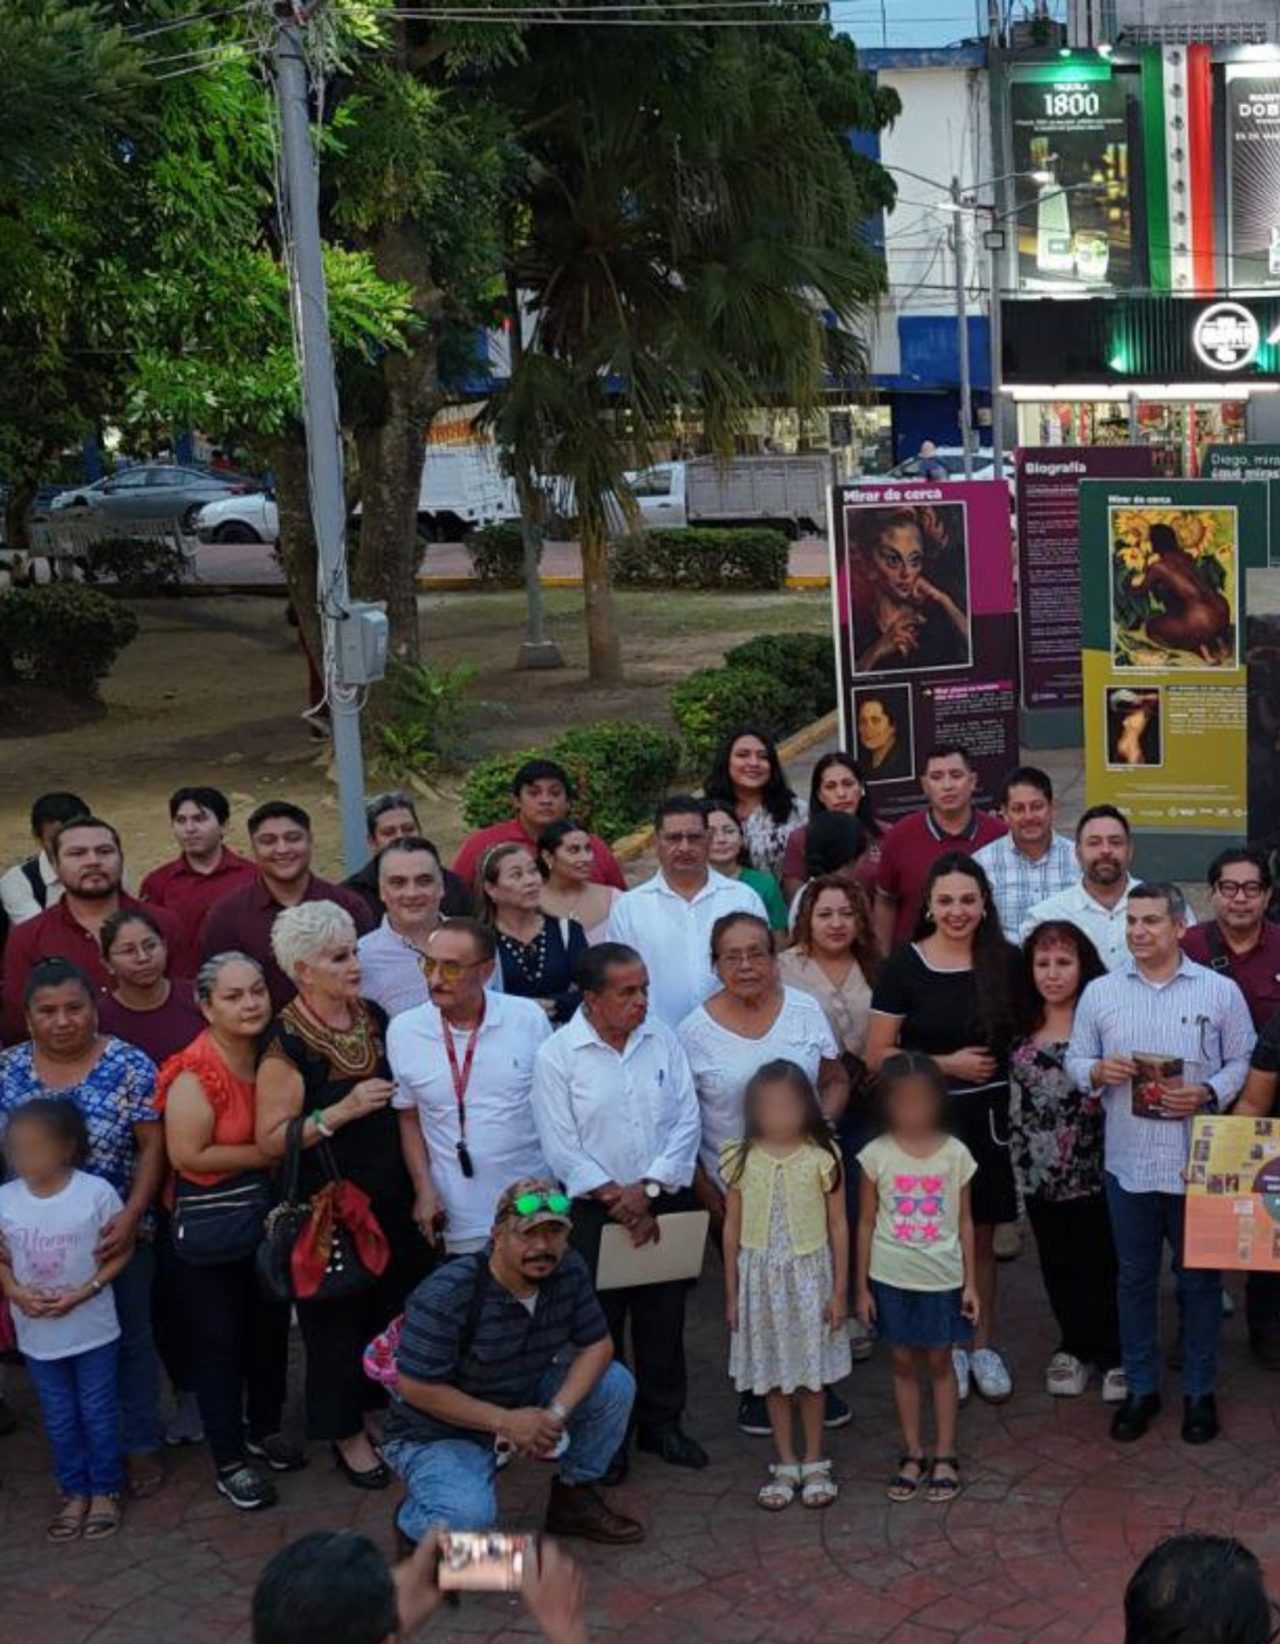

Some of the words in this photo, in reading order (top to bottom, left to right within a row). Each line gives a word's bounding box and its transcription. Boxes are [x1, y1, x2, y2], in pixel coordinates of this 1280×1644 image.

[1043, 91, 1100, 116] 1800
[843, 490, 879, 502] Mirar
[883, 488, 901, 500] de
[904, 488, 943, 500] cerca
